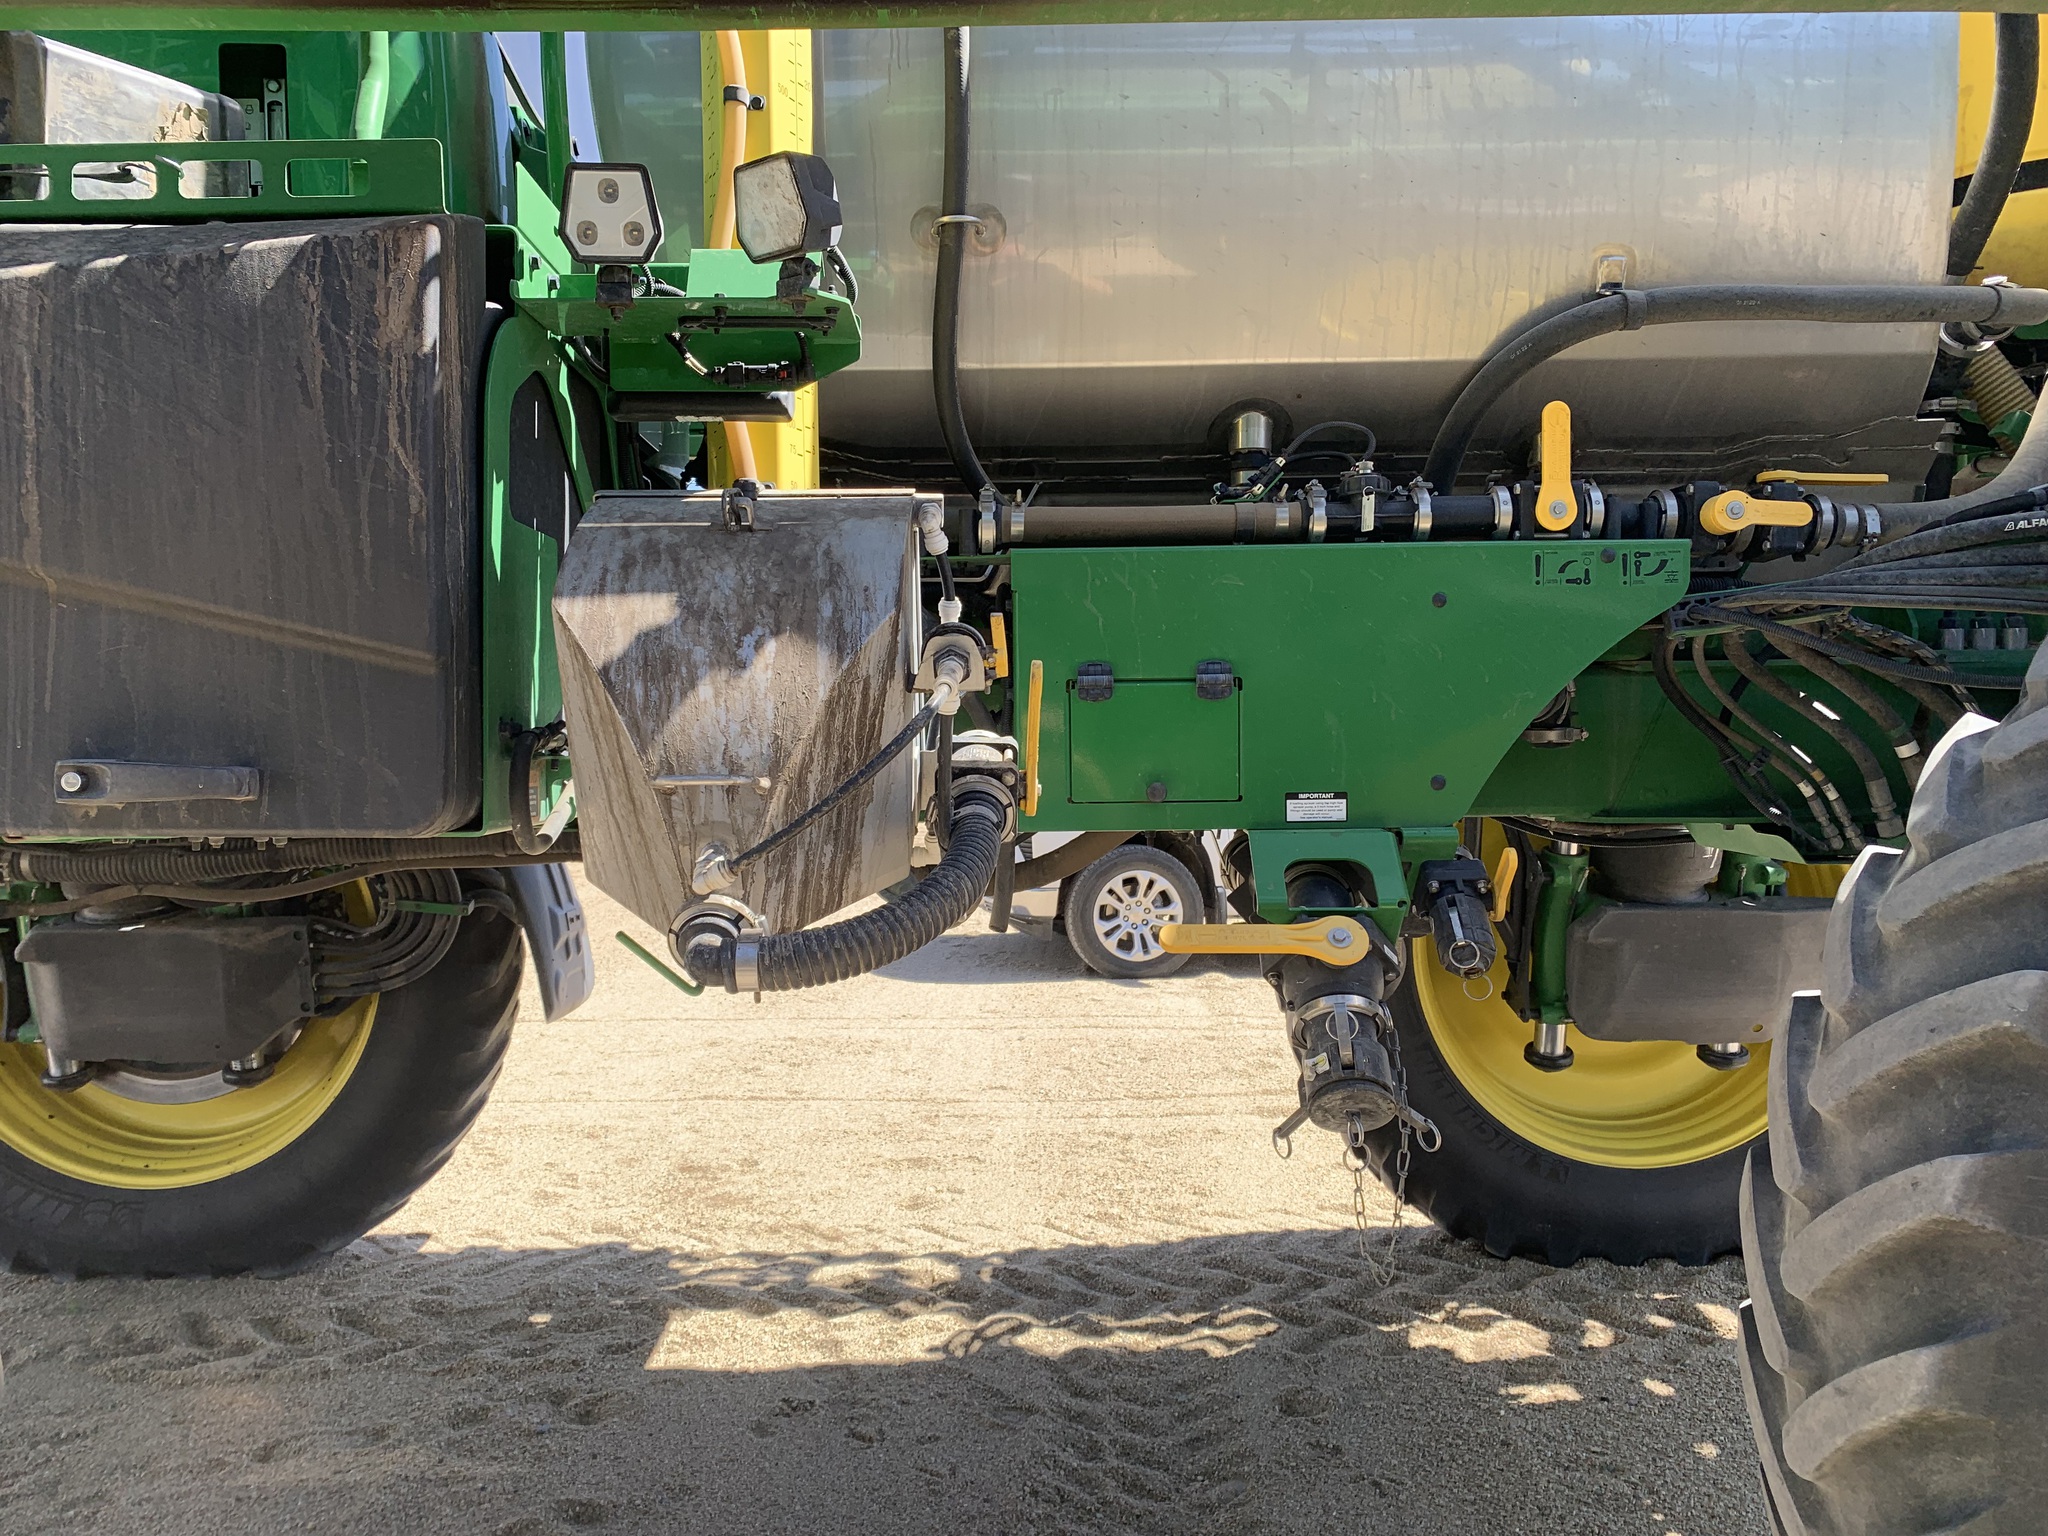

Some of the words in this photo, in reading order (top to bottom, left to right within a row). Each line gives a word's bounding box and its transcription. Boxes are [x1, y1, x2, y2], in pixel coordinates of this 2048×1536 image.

[777, 82, 789, 97] 500
[790, 444, 797, 455] 75
[2016, 518, 2048, 530] ALFA
